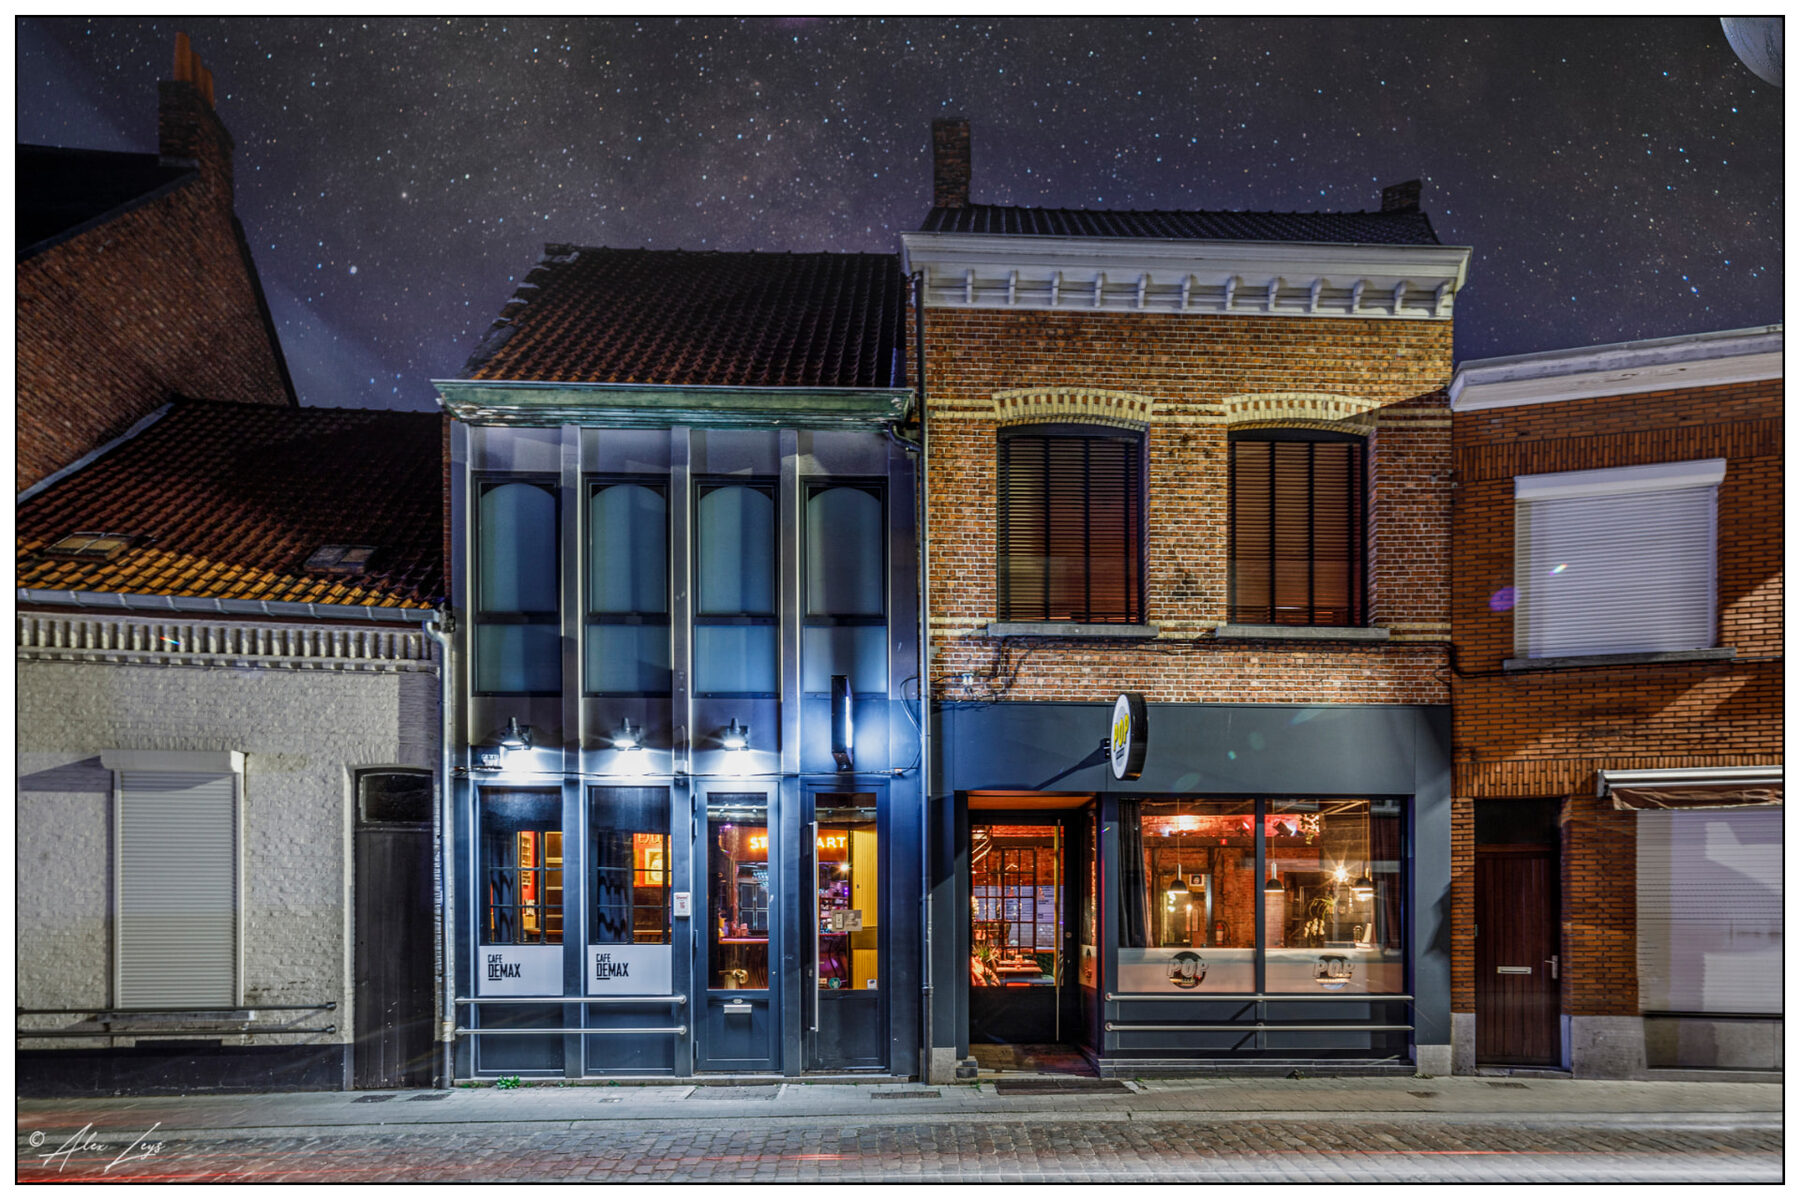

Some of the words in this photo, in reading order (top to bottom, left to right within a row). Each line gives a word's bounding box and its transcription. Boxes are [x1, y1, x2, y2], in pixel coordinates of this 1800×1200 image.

[1113, 713, 1129, 752] POP
[487, 954, 503, 963] CAFE
[596, 953, 611, 963] CAFE
[487, 963, 521, 978] DEMAX
[596, 963, 629, 977] DEMAX
[1167, 958, 1210, 978] POP
[1312, 959, 1356, 978] POP
